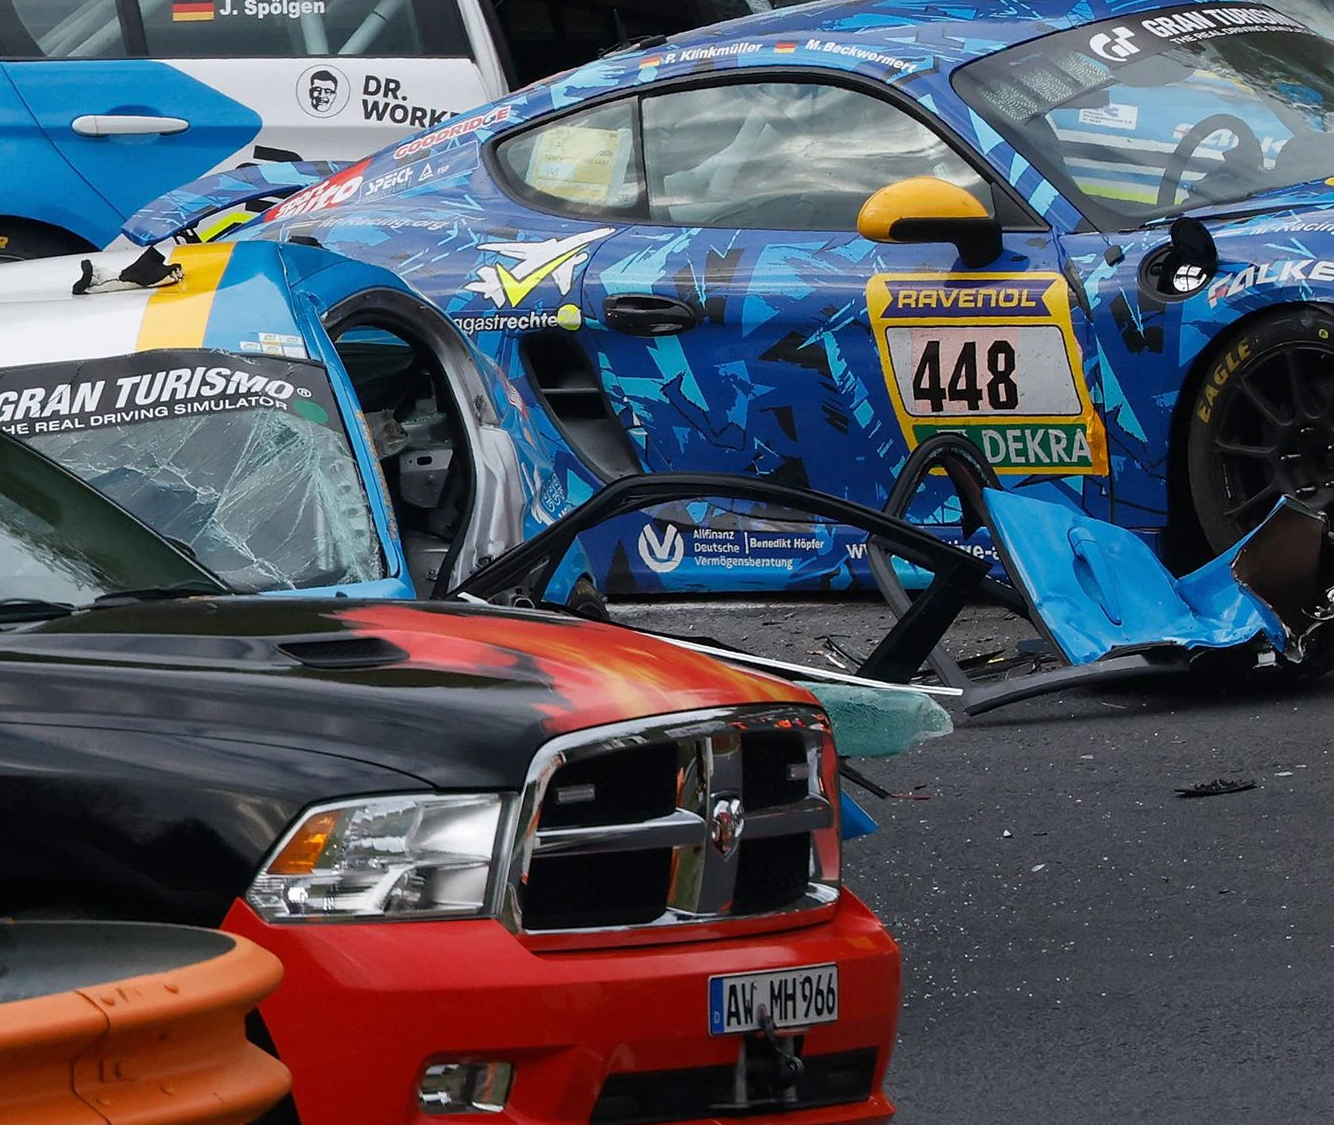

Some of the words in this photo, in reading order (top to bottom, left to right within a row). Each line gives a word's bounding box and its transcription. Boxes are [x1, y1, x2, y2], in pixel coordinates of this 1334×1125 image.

[218, 0, 238, 16] J.
[1141, 10, 1210, 38] GRAN
[679, 41, 764, 63] Klinkmüller
[362, 74, 409, 102] DR.
[393, 105, 512, 160] GOODRIDGE
[897, 288, 1036, 309] RAVENOL
[912, 340, 1018, 413] 448
[1196, 337, 1252, 424] EAGLE
[34, 417, 86, 434] REAL
[89, 405, 169, 426] DRIVING
[173, 394, 288, 417] SIMULATOR
[980, 428, 1092, 464] DEKRA
[694, 542, 740, 554] Deutsche
[749, 536, 791, 550] Benedikt
[793, 535, 825, 551] Höpfer
[694, 556, 794, 571] Vermögensberatung
[726, 982, 755, 1027] AW
[770, 977, 797, 1021] MH
[801, 973, 836, 1019] 966
